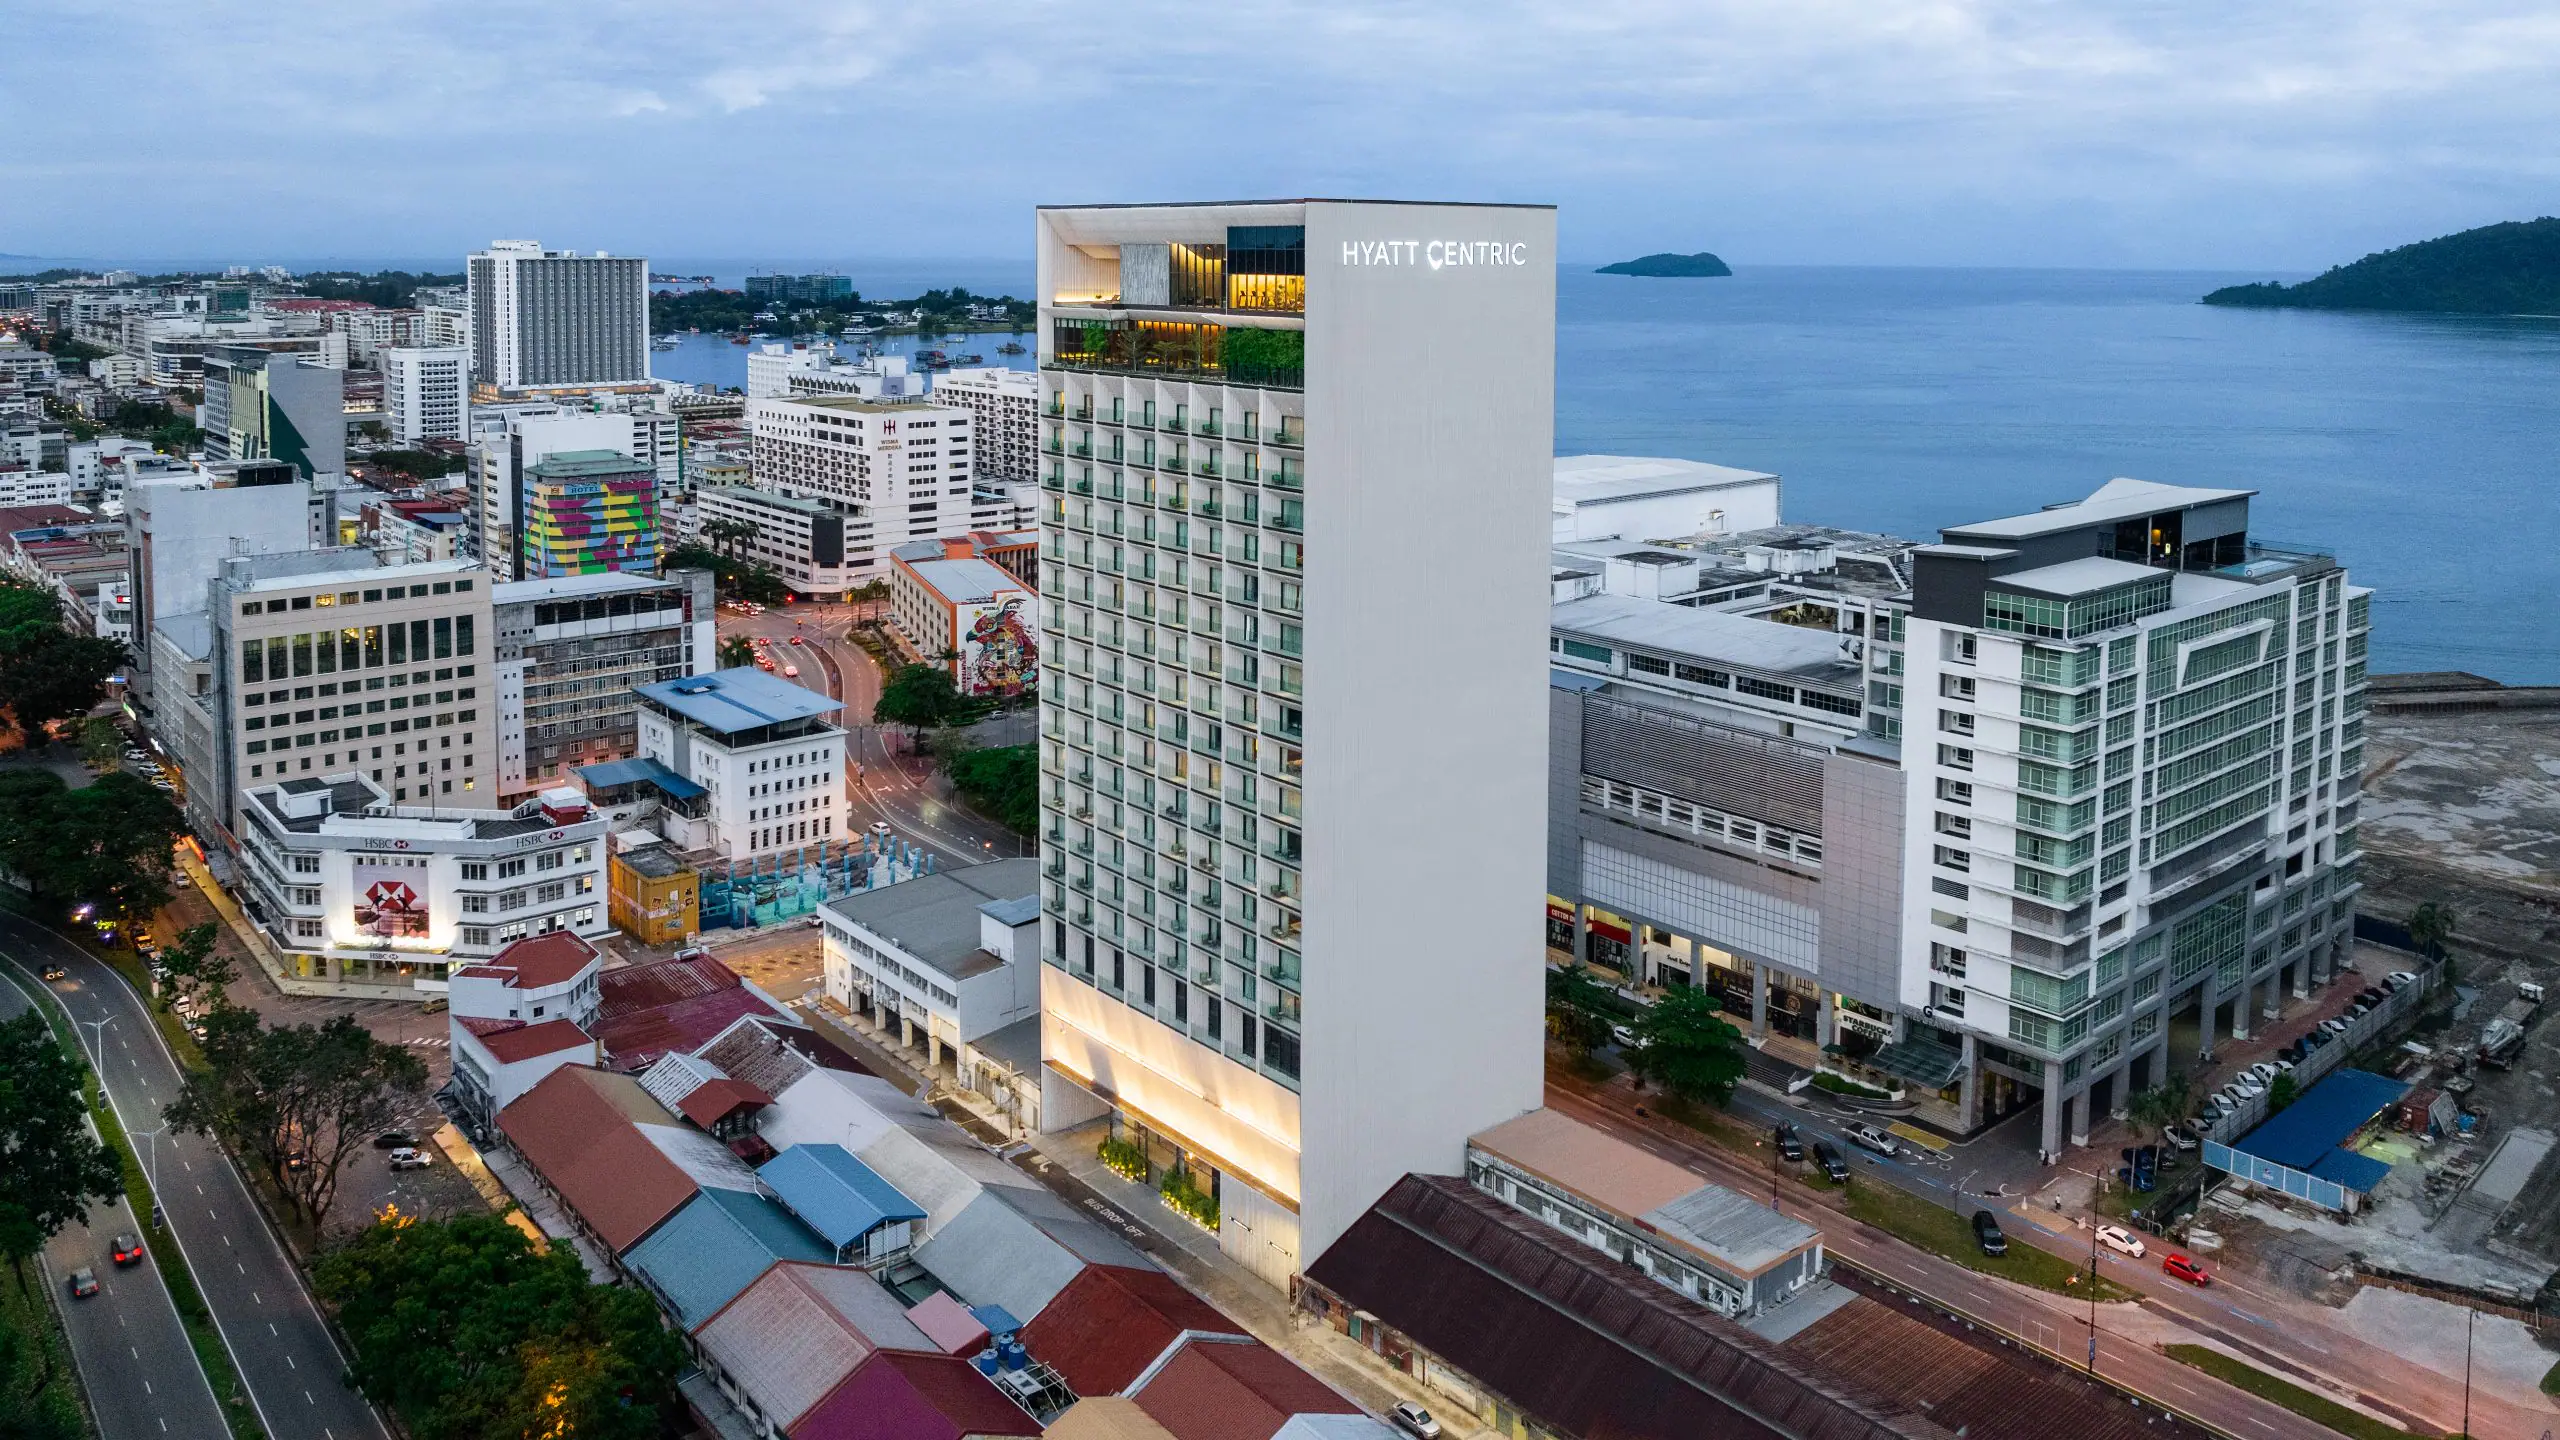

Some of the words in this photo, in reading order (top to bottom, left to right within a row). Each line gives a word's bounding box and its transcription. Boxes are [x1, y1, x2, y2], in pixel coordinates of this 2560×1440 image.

[1343, 241, 1420, 266] HYATT
[1426, 240, 1527, 270] CENTRIC
[571, 486, 600, 494] HOTEL
[364, 838, 392, 849] HSBC
[516, 833, 546, 848] HSBC
[1551, 909, 1569, 921] COTTON
[369, 952, 388, 960] HSBC
[1922, 1005, 1933, 1018] G
[1843, 1015, 1894, 1038] STARBUCKS
[1851, 1024, 1884, 1041] COFFEE
[1084, 1198, 1104, 1210] BUS
[1100, 1208, 1125, 1223] DROP
[1125, 1225, 1146, 1237] OFF
